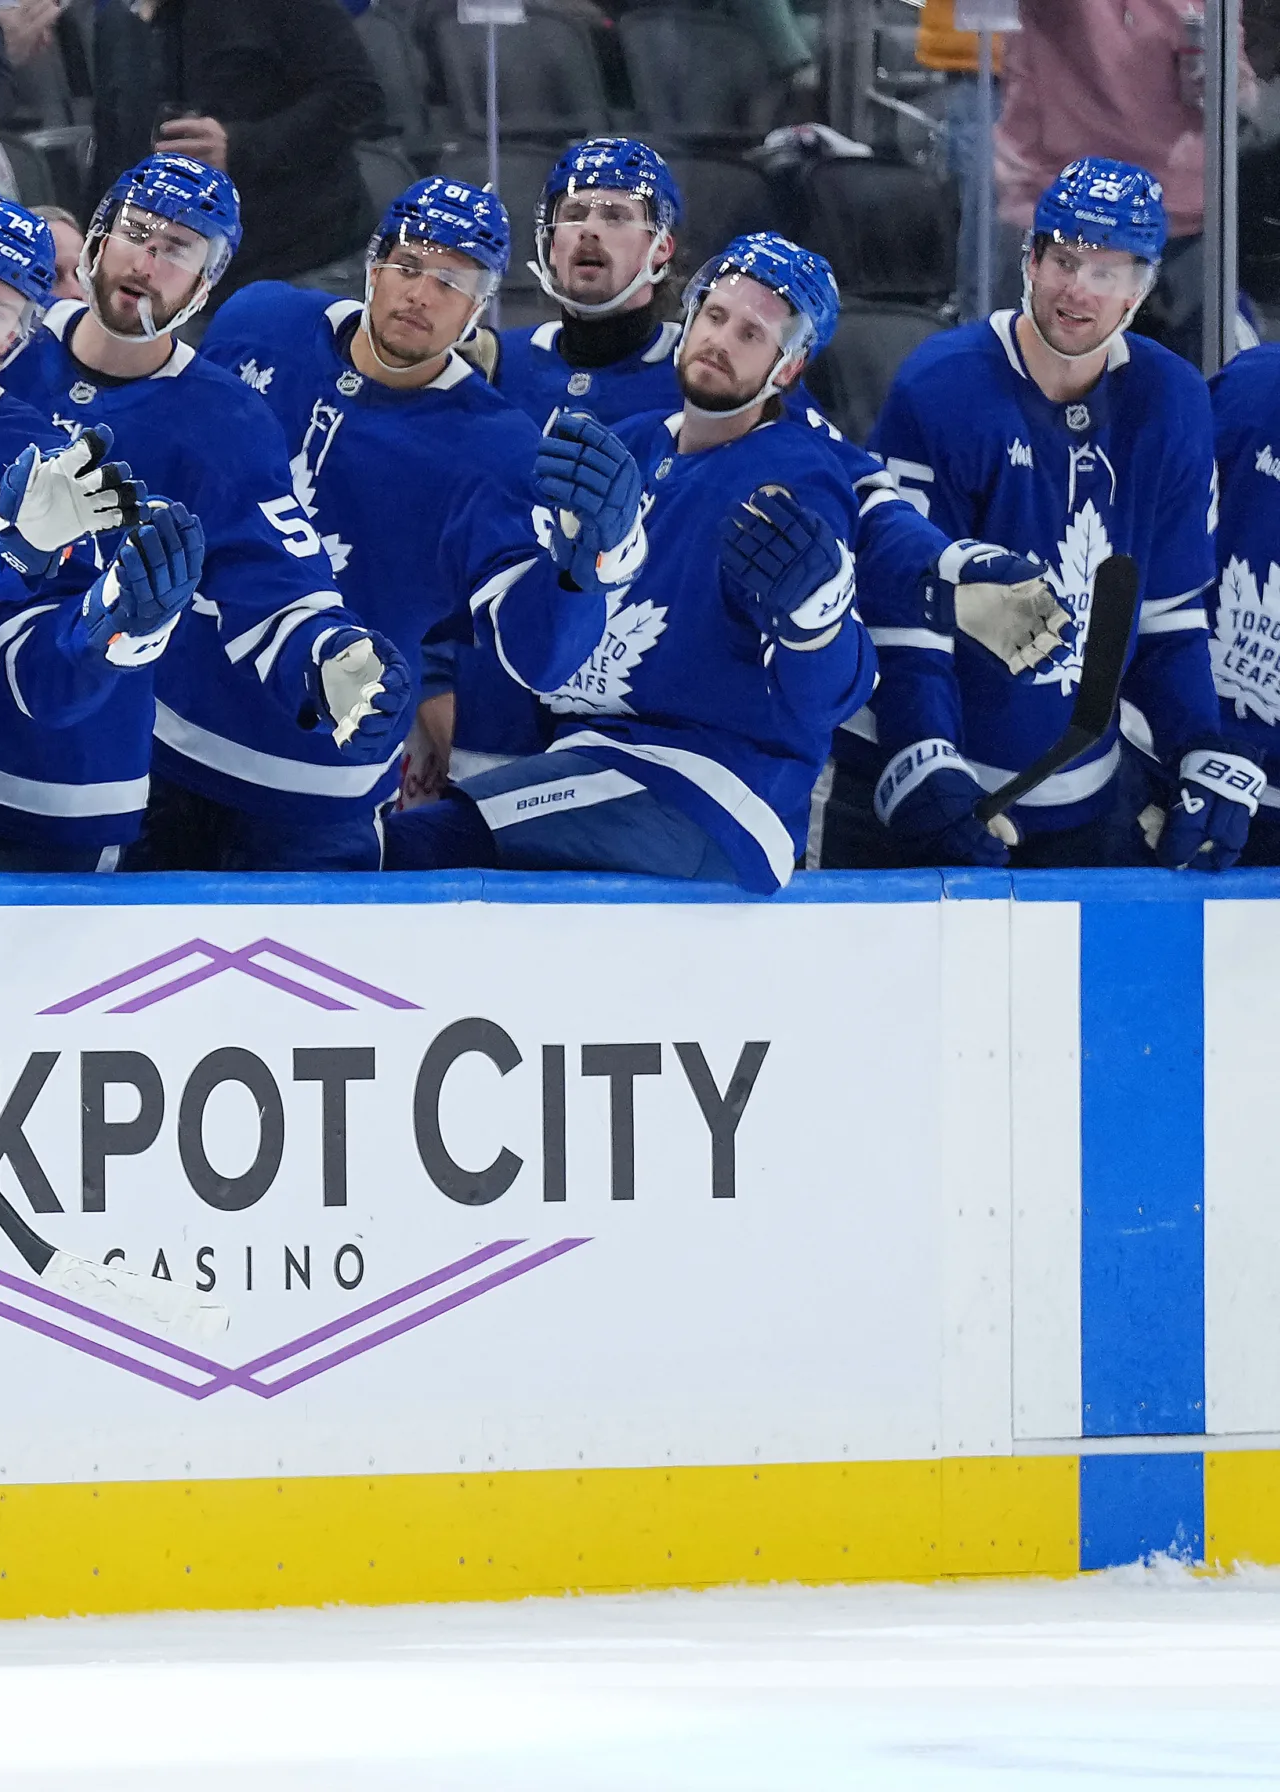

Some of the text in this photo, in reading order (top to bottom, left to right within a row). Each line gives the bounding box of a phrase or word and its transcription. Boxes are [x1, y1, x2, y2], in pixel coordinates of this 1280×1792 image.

[152, 180, 193, 201] CCM
[426, 207, 474, 230] CCM
[412, 1015, 771, 1206] CITY
